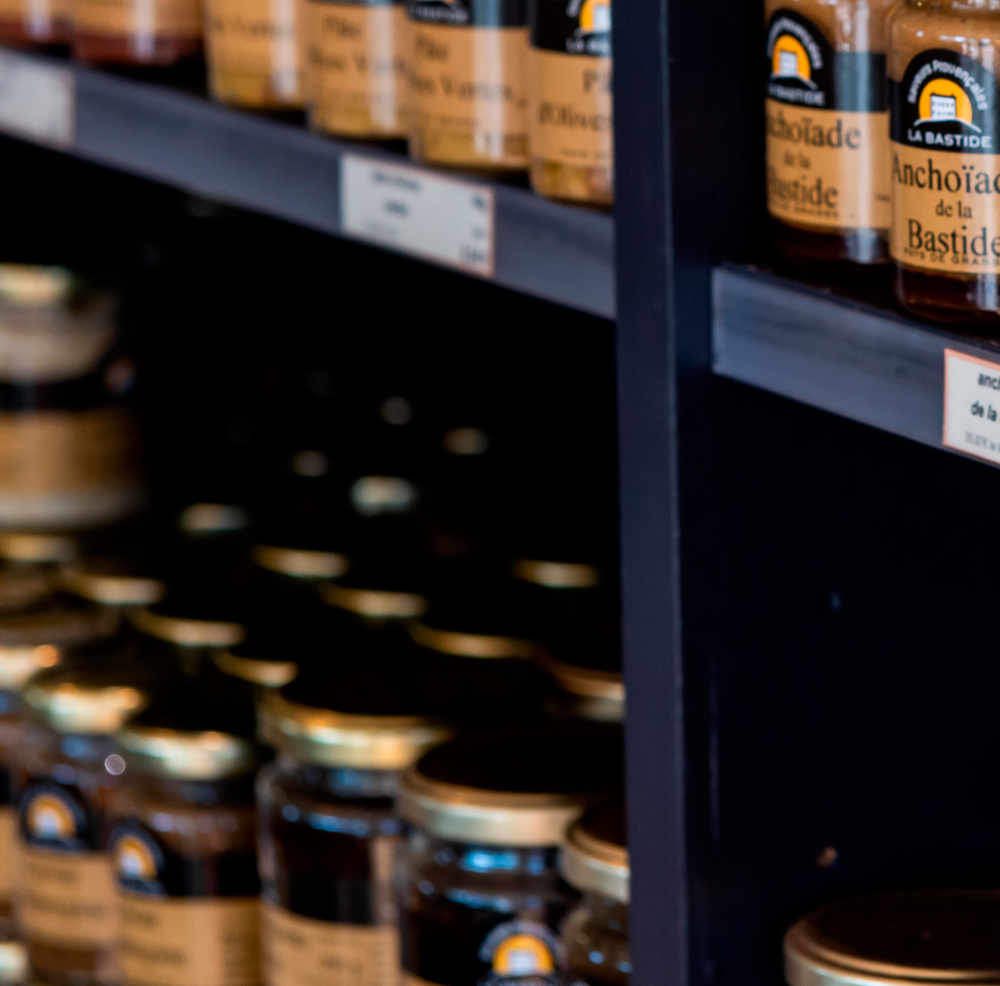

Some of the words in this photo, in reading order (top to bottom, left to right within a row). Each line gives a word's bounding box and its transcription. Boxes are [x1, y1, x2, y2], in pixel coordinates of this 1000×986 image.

[908, 129, 923, 142] LA
[925, 132, 992, 149] BASTIDE
[935, 199, 953, 217] de
[959, 200, 972, 219] la
[971, 401, 984, 415] de
[987, 404, 997, 422] la
